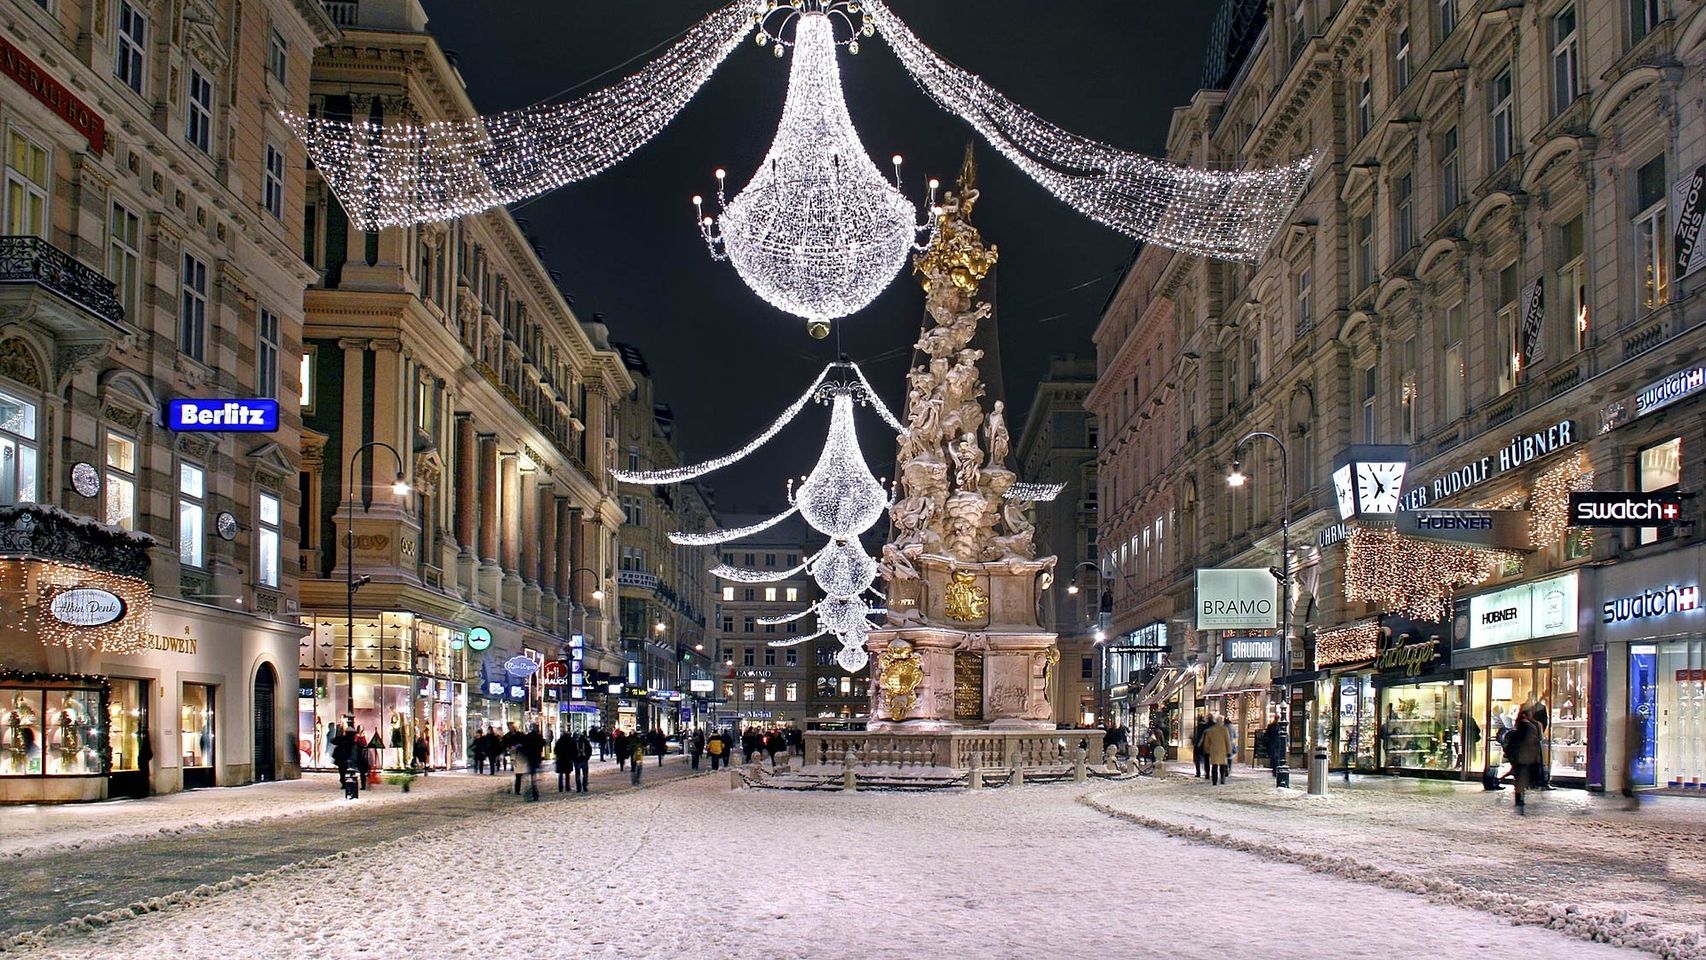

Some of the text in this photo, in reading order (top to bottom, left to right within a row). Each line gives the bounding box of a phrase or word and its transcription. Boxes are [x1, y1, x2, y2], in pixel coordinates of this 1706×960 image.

[0, 43, 98, 134] NERALI HOF
[1678, 175, 1704, 239] ZIKOS
[1679, 213, 1703, 267] FURS
[1525, 284, 1542, 335] ZIKOS
[1526, 306, 1544, 359] PELZE
[181, 403, 264, 425] Berlitz
[1434, 456, 1490, 500] RUDOLF
[1499, 420, 1571, 472] HÜBNER
[1577, 499, 1662, 520] swatch
[86, 600, 116, 613] Denk
[1203, 599, 1271, 615] BRAMO
[1603, 585, 1678, 624] swatch
